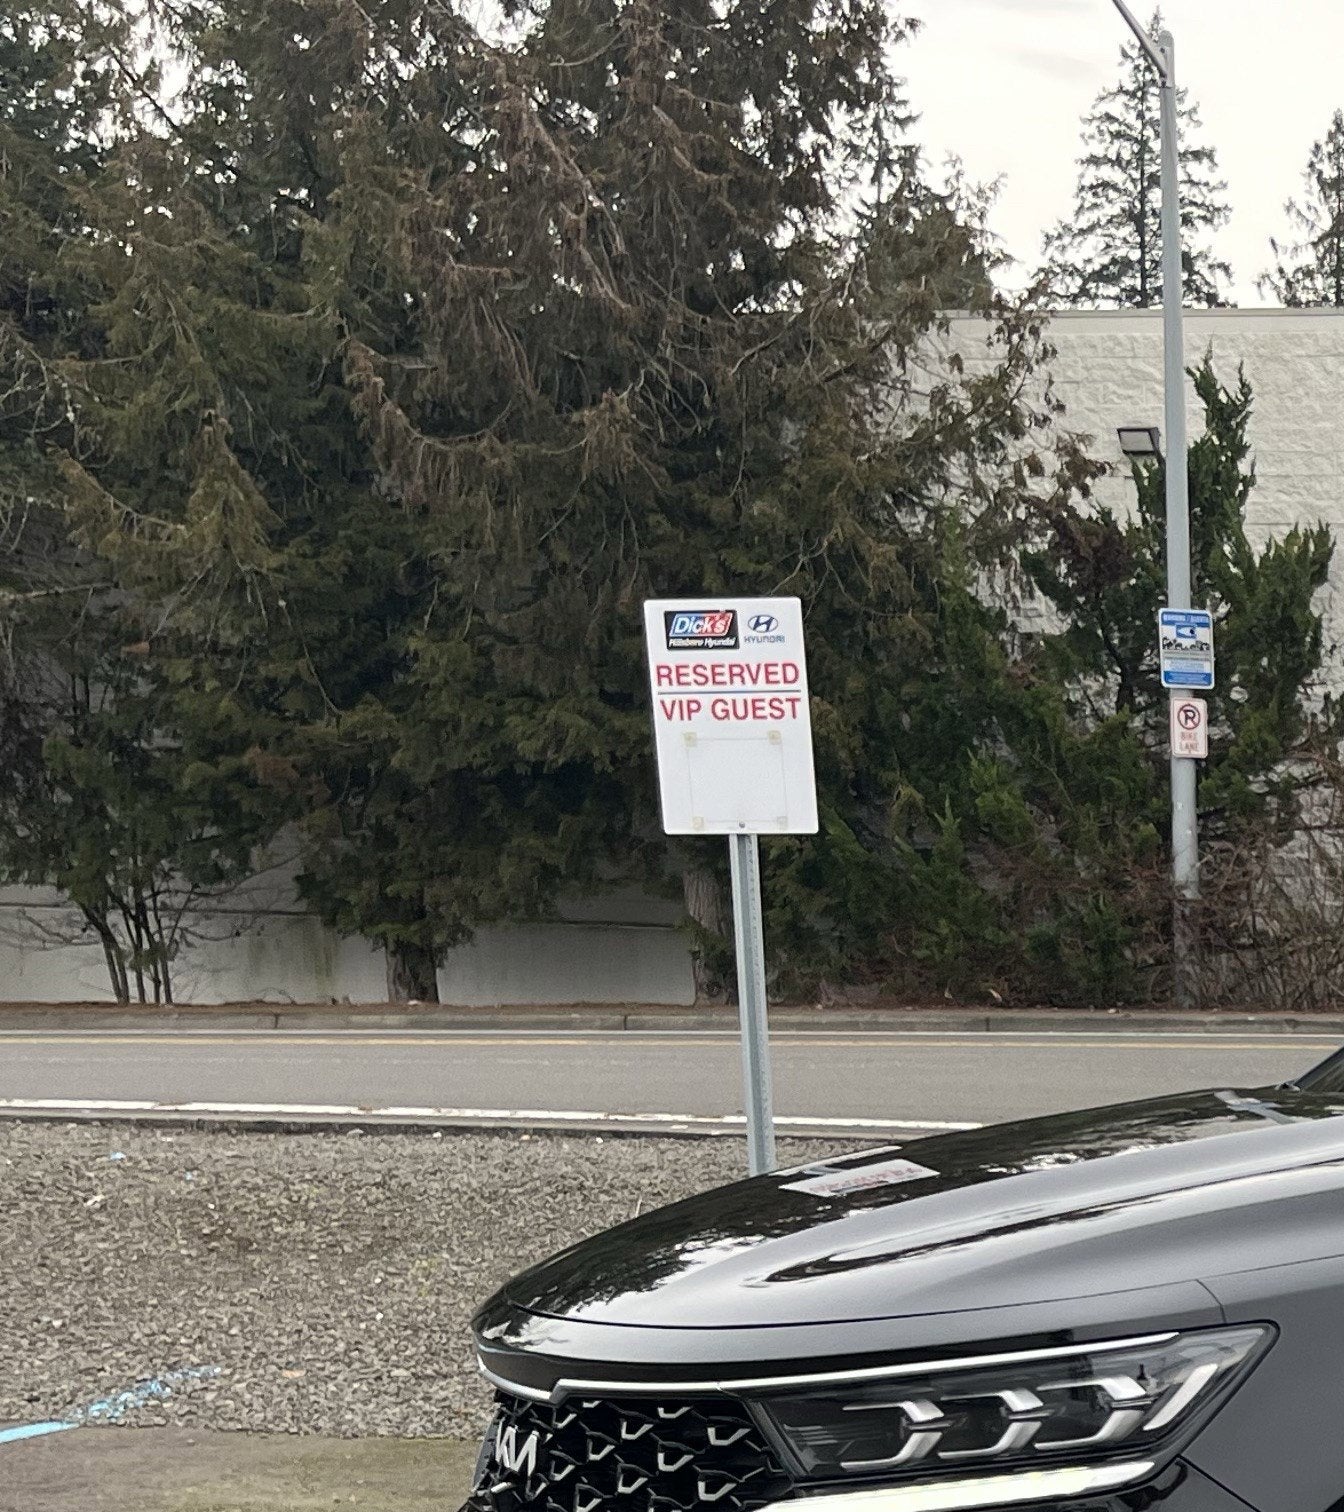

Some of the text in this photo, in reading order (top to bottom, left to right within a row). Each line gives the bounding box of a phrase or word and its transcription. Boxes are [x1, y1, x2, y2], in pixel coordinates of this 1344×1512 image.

[675, 615, 726, 633] Dick's
[744, 635, 785, 643] HYUNDAI
[656, 663, 799, 686] RESERVED
[660, 697, 801, 721] VIP GUEST
